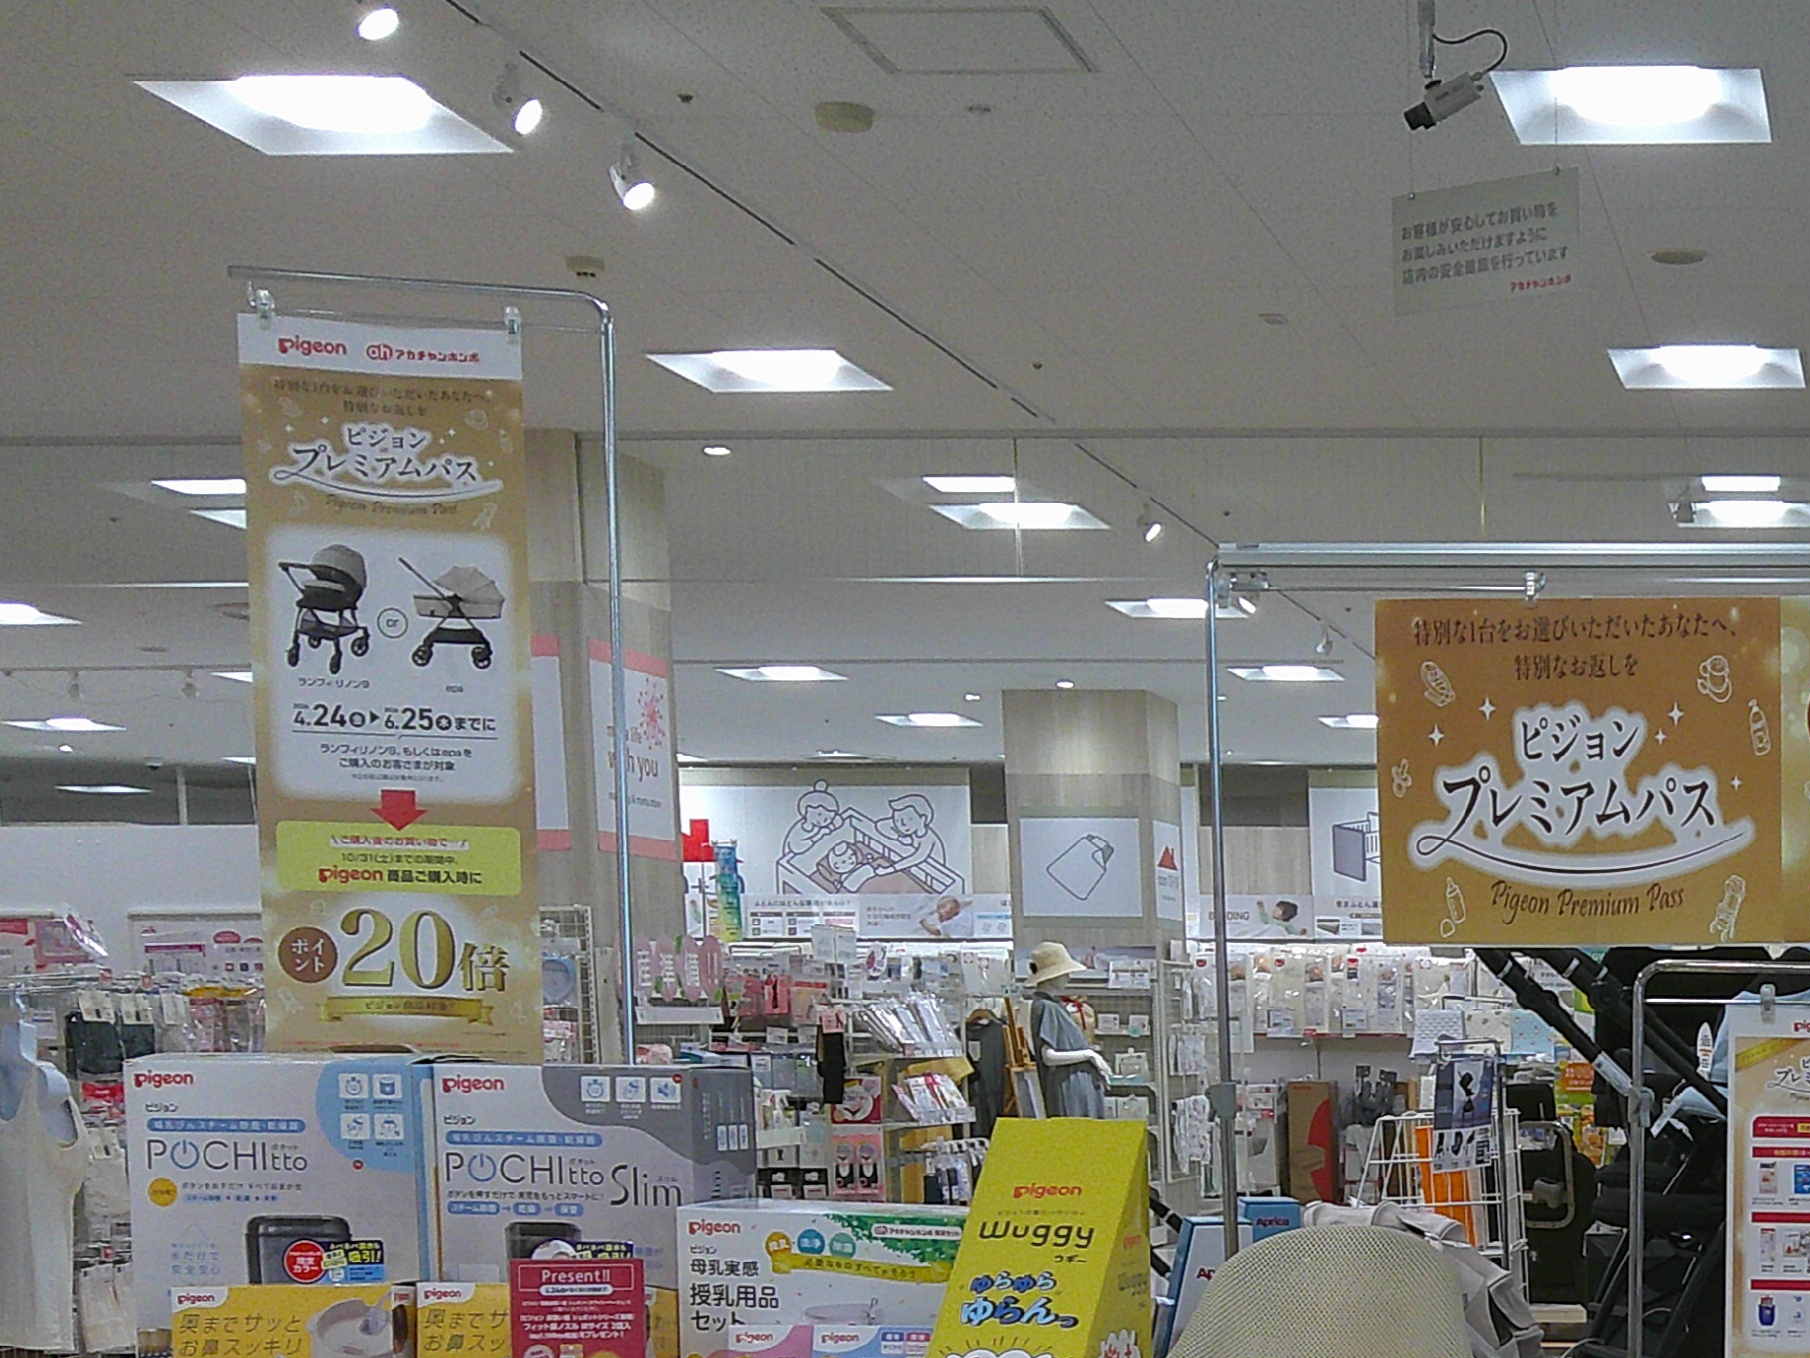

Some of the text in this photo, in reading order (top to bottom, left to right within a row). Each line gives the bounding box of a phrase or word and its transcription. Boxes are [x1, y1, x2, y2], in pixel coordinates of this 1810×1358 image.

[278, 335, 347, 356] pigeon
[395, 350, 480, 363] アカチャンホンポ
[347, 427, 427, 449] ピジョン
[293, 444, 477, 482] プレミアムパス
[1513, 654, 1638, 679] 特別なお返しを
[1522, 714, 1639, 761] ピジョン
[637, 756, 658, 782] you
[1442, 765, 1716, 837] プレミアムパス
[318, 865, 482, 885] pigeon 商品ご購入時に
[1491, 880, 1685, 926] Pigeon Premium Pass
[1208, 911, 1249, 921] BDING
[618, 949, 719, 988] 産準備!!
[134, 1071, 194, 1088] pigeon
[442, 1077, 505, 1093] pigeon
[145, 1103, 178, 1113] ピジョン
[444, 1115, 475, 1125] ピジョン
[610, 1164, 682, 1208] Slim
[1013, 1183, 1082, 1198] pigeon
[689, 1219, 741, 1235] pigeon
[979, 1220, 1094, 1248] Wuggy
[690, 1245, 717, 1254] ピジョン
[690, 1260, 759, 1277] 母乳実感
[970, 1271, 1057, 1293] ゆらゆら
[177, 1293, 215, 1304] pigeon
[424, 1288, 462, 1300] pigeon
[689, 1283, 779, 1309] 授乳用品
[179, 1314, 301, 1334] 奥までサッと
[424, 1309, 509, 1329] 奥までサ
[690, 1311, 745, 1332] セット
[179, 1337, 302, 1358] お鼻スッキリ
[424, 1334, 506, 1352] お鼻スッ
[735, 1332, 773, 1344] pigeon
[821, 1332, 860, 1344] pigeon
